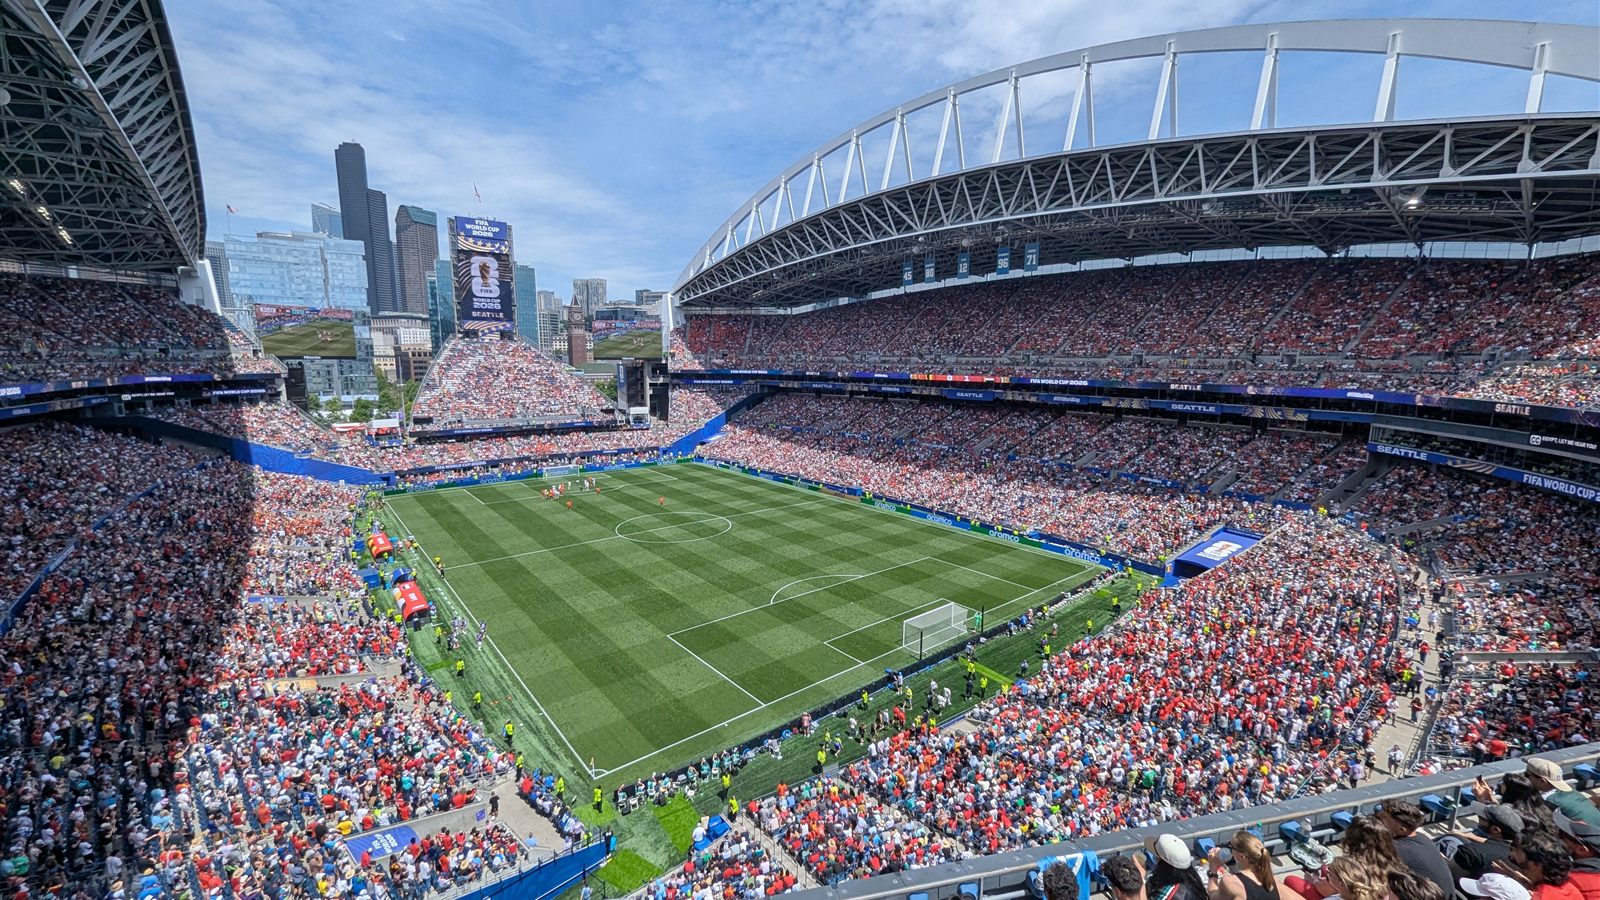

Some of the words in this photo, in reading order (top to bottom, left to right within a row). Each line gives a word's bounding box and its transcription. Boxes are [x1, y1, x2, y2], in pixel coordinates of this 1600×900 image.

[998, 258, 1008, 269] 96
[1026, 254, 1036, 266] 71
[926, 268, 934, 278] 80
[959, 262, 968, 273] 12
[903, 271, 912, 281] 45
[1170, 403, 1216, 412] SEATTLE
[1495, 403, 1530, 416] SEATTLE
[1376, 445, 1427, 460] SEATTLE
[1523, 474, 1541, 487] FIFA
[1544, 478, 1576, 494] WORLD
[1577, 486, 1595, 500] CUP
[874, 500, 896, 511] aramco
[927, 514, 952, 526] aramco
[989, 530, 1019, 542] aramco
[1064, 548, 1100, 563] aramco
